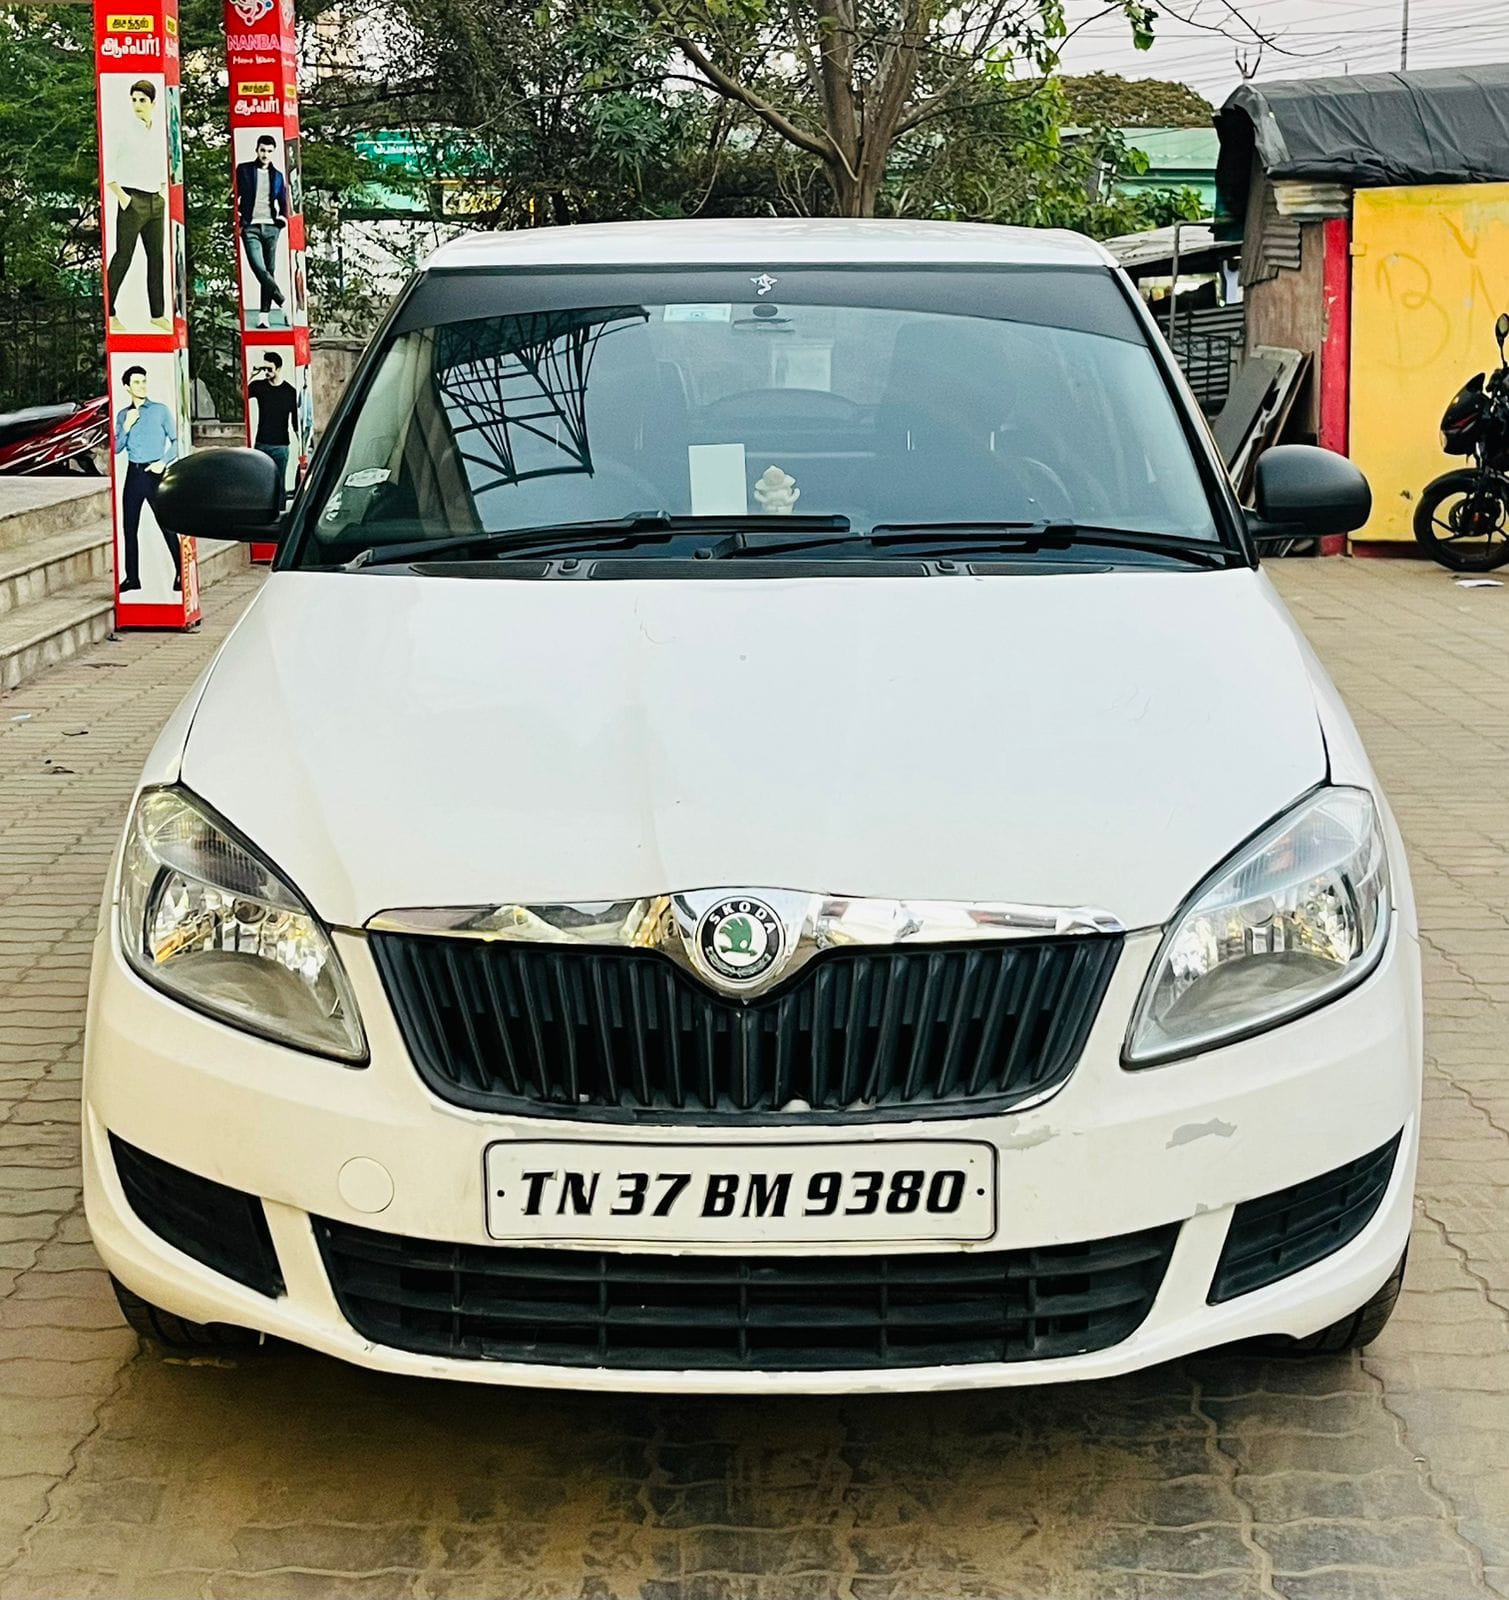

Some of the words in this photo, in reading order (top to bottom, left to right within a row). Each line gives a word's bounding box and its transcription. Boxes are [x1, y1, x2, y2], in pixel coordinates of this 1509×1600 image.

[101, 33, 161, 58] ஆஃபர்!
[227, 33, 280, 51] NANBA
[709, 900, 777, 934] SKODA
[520, 1170, 601, 1216] TN
[610, 1171, 692, 1217] 37
[700, 1172, 793, 1218] BM
[803, 1170, 967, 1217] 9380
